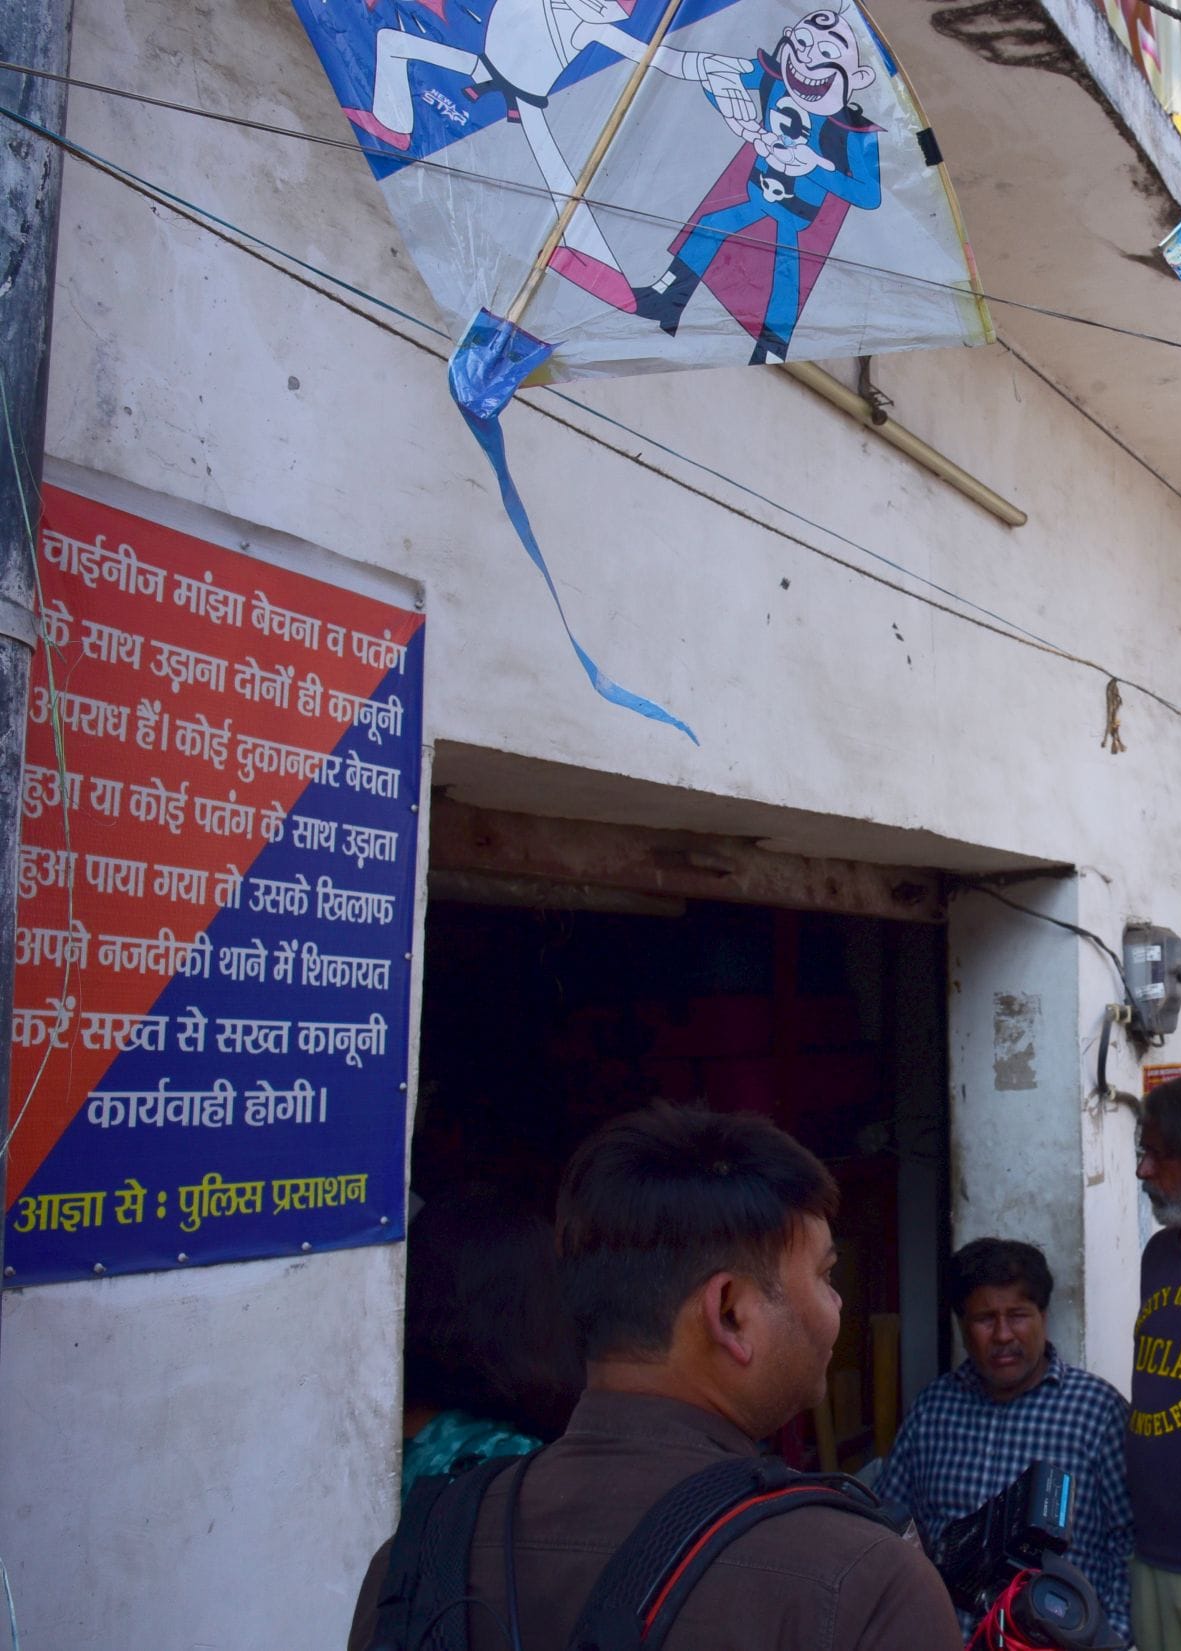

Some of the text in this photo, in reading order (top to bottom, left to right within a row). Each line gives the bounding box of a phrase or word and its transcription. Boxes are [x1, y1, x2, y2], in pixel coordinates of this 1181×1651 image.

[422, 91, 469, 126] STAR
[430, 88, 454, 106] NEW
[42, 528, 408, 675] चाईनीज मांझा बेचना व पतंग
[39, 600, 404, 745] के साथ उड़ाना दोनों ही कानूनी
[30, 687, 130, 742] अपराध
[176, 713, 231, 769] कोई
[237, 734, 342, 787] दुकानदार
[346, 750, 401, 800] बेचता
[22, 764, 398, 869] हुआ या कोई पतंग के साथ उड़ाता
[17, 844, 395, 925] हुआ पाया गया तो उसके खिलाफ
[16, 920, 391, 990] अपने नजदीकी थाने में शिकायत
[12, 996, 387, 1068] करें सख्त से सख्त कानूनी
[87, 1078, 236, 1128] कार्यवाही
[13, 1192, 106, 1233] आज्ञा
[115, 1179, 147, 1224] से
[179, 1172, 265, 1232] पुलिस
[272, 1173, 368, 1216] प्रसाशन
